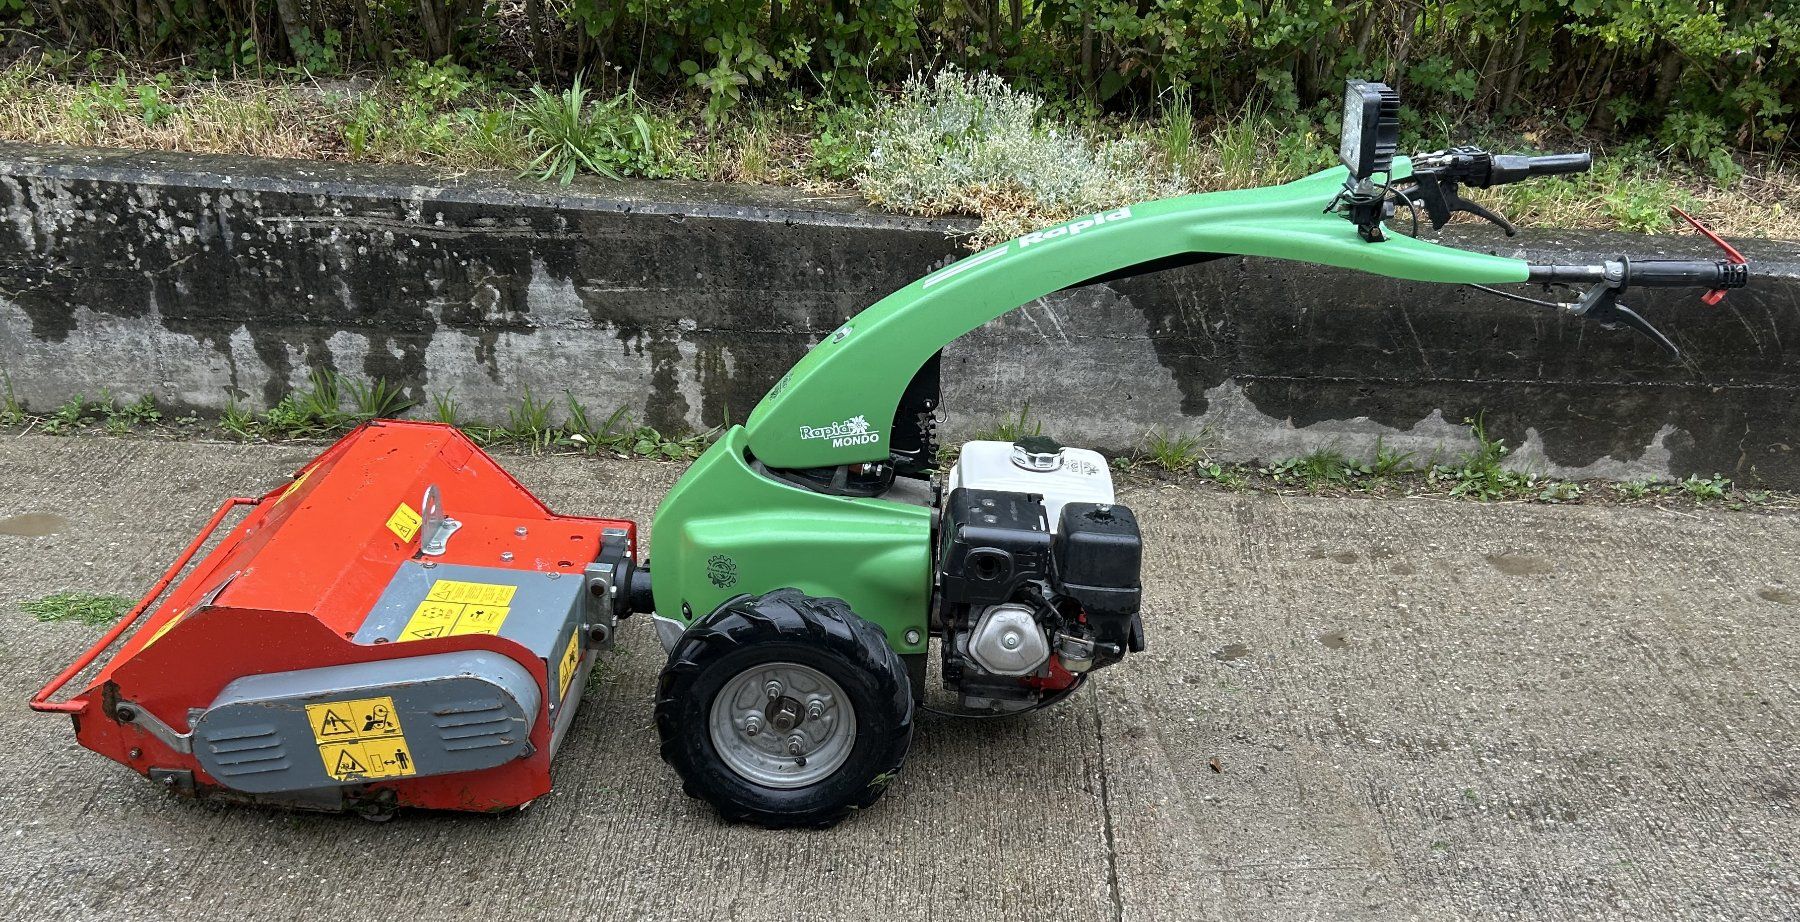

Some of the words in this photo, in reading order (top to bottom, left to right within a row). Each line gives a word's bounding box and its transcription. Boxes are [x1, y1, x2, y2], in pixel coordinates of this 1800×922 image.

[1018, 207, 1132, 248] Rapid
[800, 420, 853, 439] Rapid
[832, 433, 879, 448] MONDO
